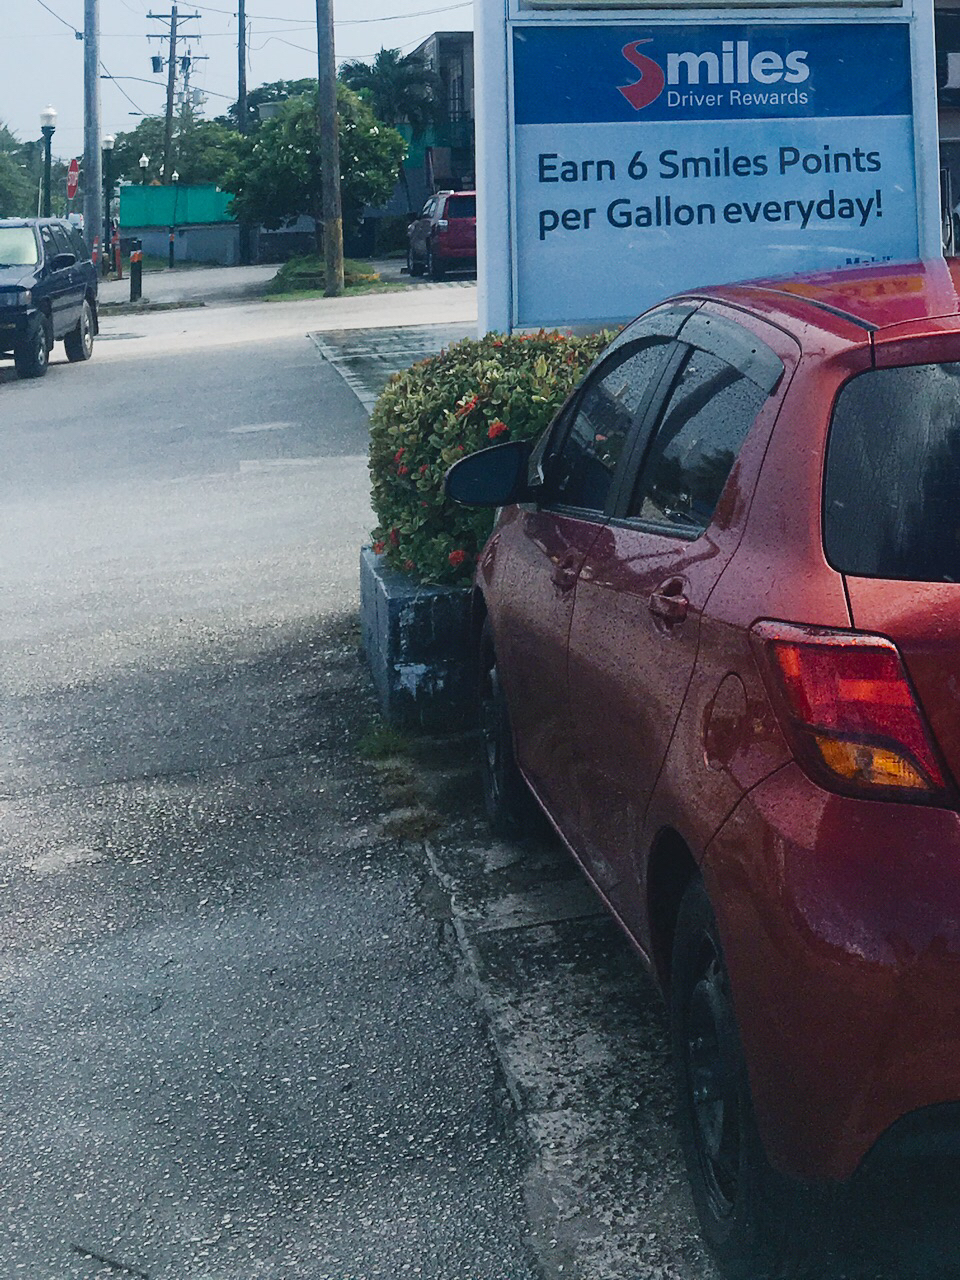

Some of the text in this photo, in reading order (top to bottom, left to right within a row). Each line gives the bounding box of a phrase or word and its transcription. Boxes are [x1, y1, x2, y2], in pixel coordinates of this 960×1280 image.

[617, 38, 811, 111] Smiles
[667, 88, 808, 108] Driver Rewards
[538, 145, 882, 183] Earn 6 Smiles Points
[538, 189, 883, 241] per Gallon everyday!
